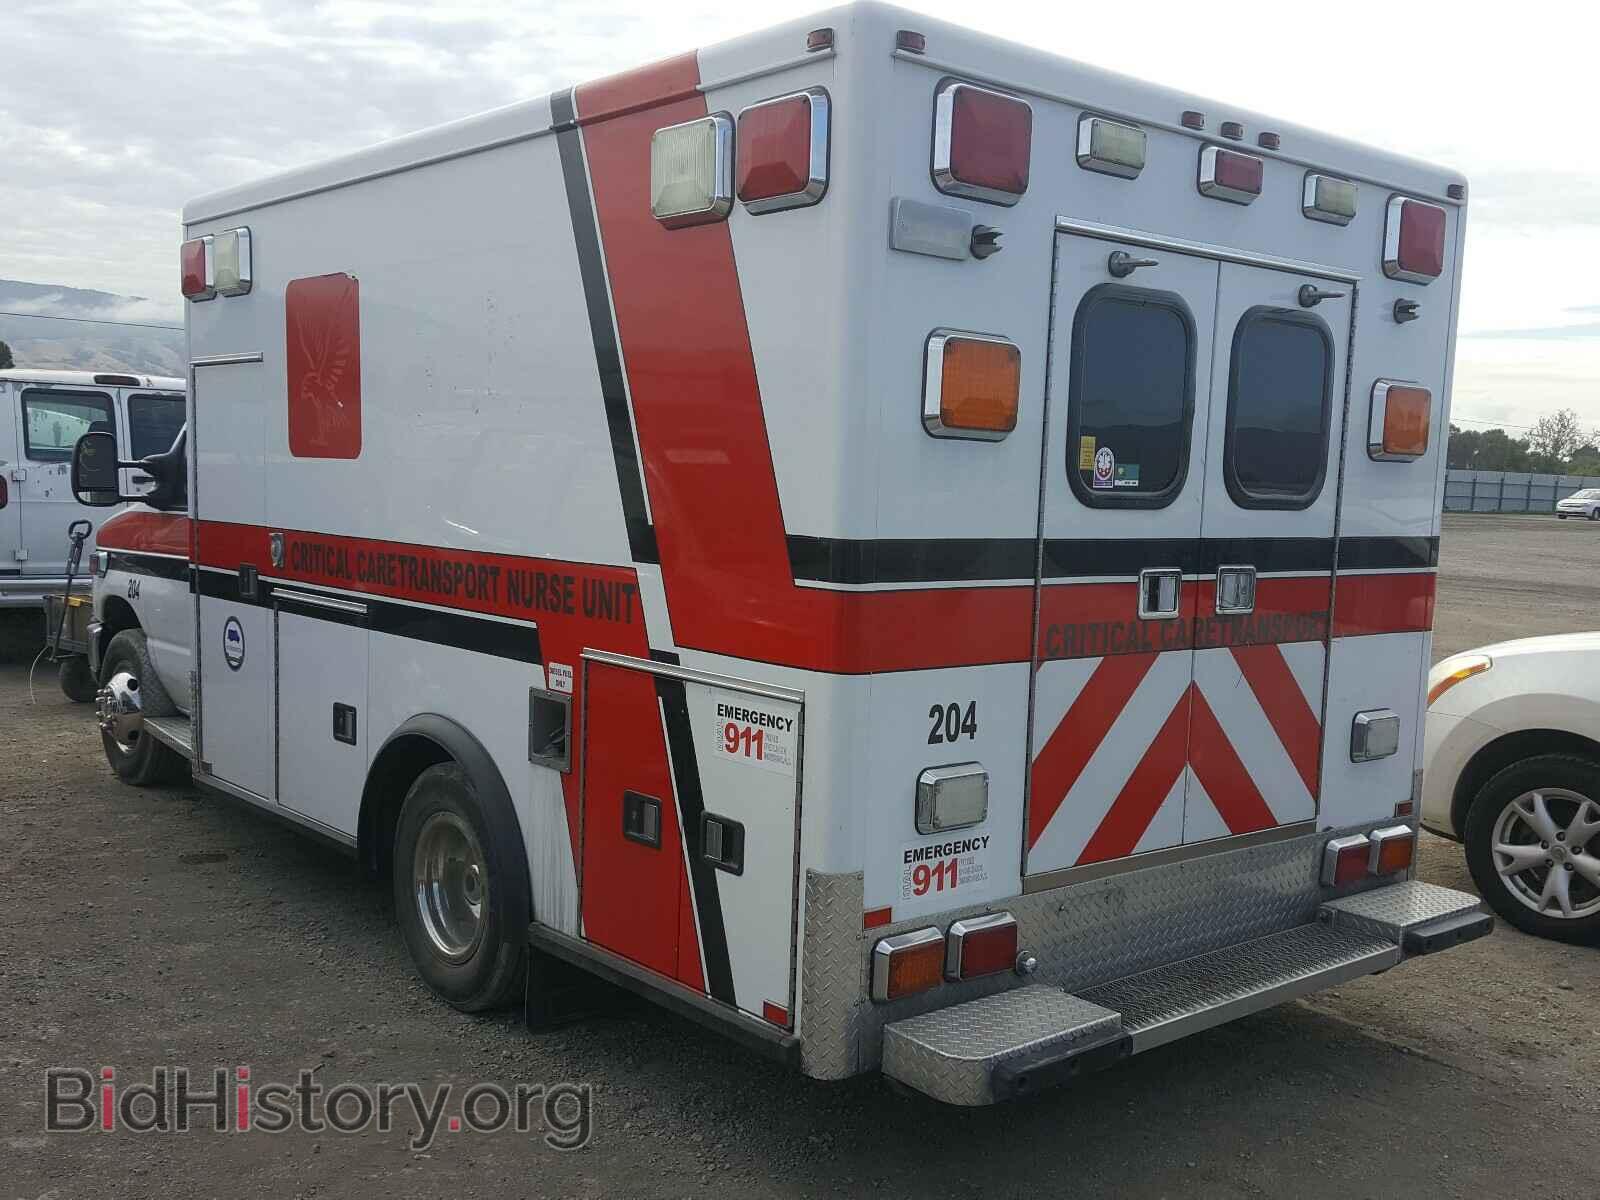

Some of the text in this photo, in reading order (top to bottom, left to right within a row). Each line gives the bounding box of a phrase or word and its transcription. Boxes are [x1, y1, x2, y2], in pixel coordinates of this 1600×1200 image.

[128, 579, 141, 600] 204
[291, 541, 352, 580] CRITICAL
[507, 569, 577, 615] NURSE
[582, 577, 636, 624] UNIT
[1046, 620, 1153, 656] CRITICAL
[717, 703, 793, 732] EMERGENCY
[927, 700, 978, 745] 204
[724, 722, 764, 761] 911
[903, 835, 990, 864] EMERGENCY
[912, 857, 958, 896] 911
